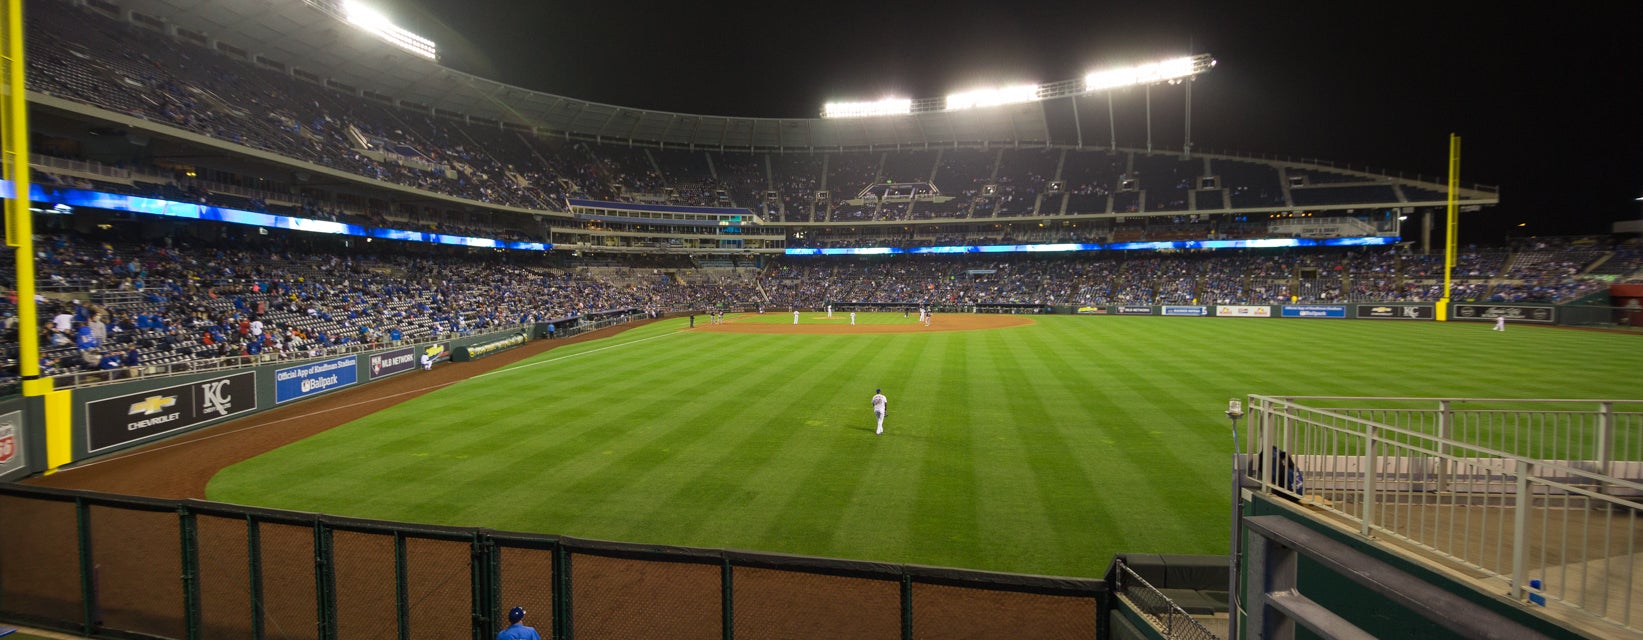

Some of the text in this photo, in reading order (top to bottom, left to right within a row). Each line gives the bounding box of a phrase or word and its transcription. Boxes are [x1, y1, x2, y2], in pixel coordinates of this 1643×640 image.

[382, 353, 414, 368] MLB NETWORK
[277, 370, 297, 381] Official
[298, 368, 308, 378] App
[314, 363, 337, 373] Kauffman
[337, 359, 355, 369] Stadium
[310, 373, 338, 389] Ballpark
[202, 379, 232, 414] KC
[128, 412, 180, 430] CHEVROLET
